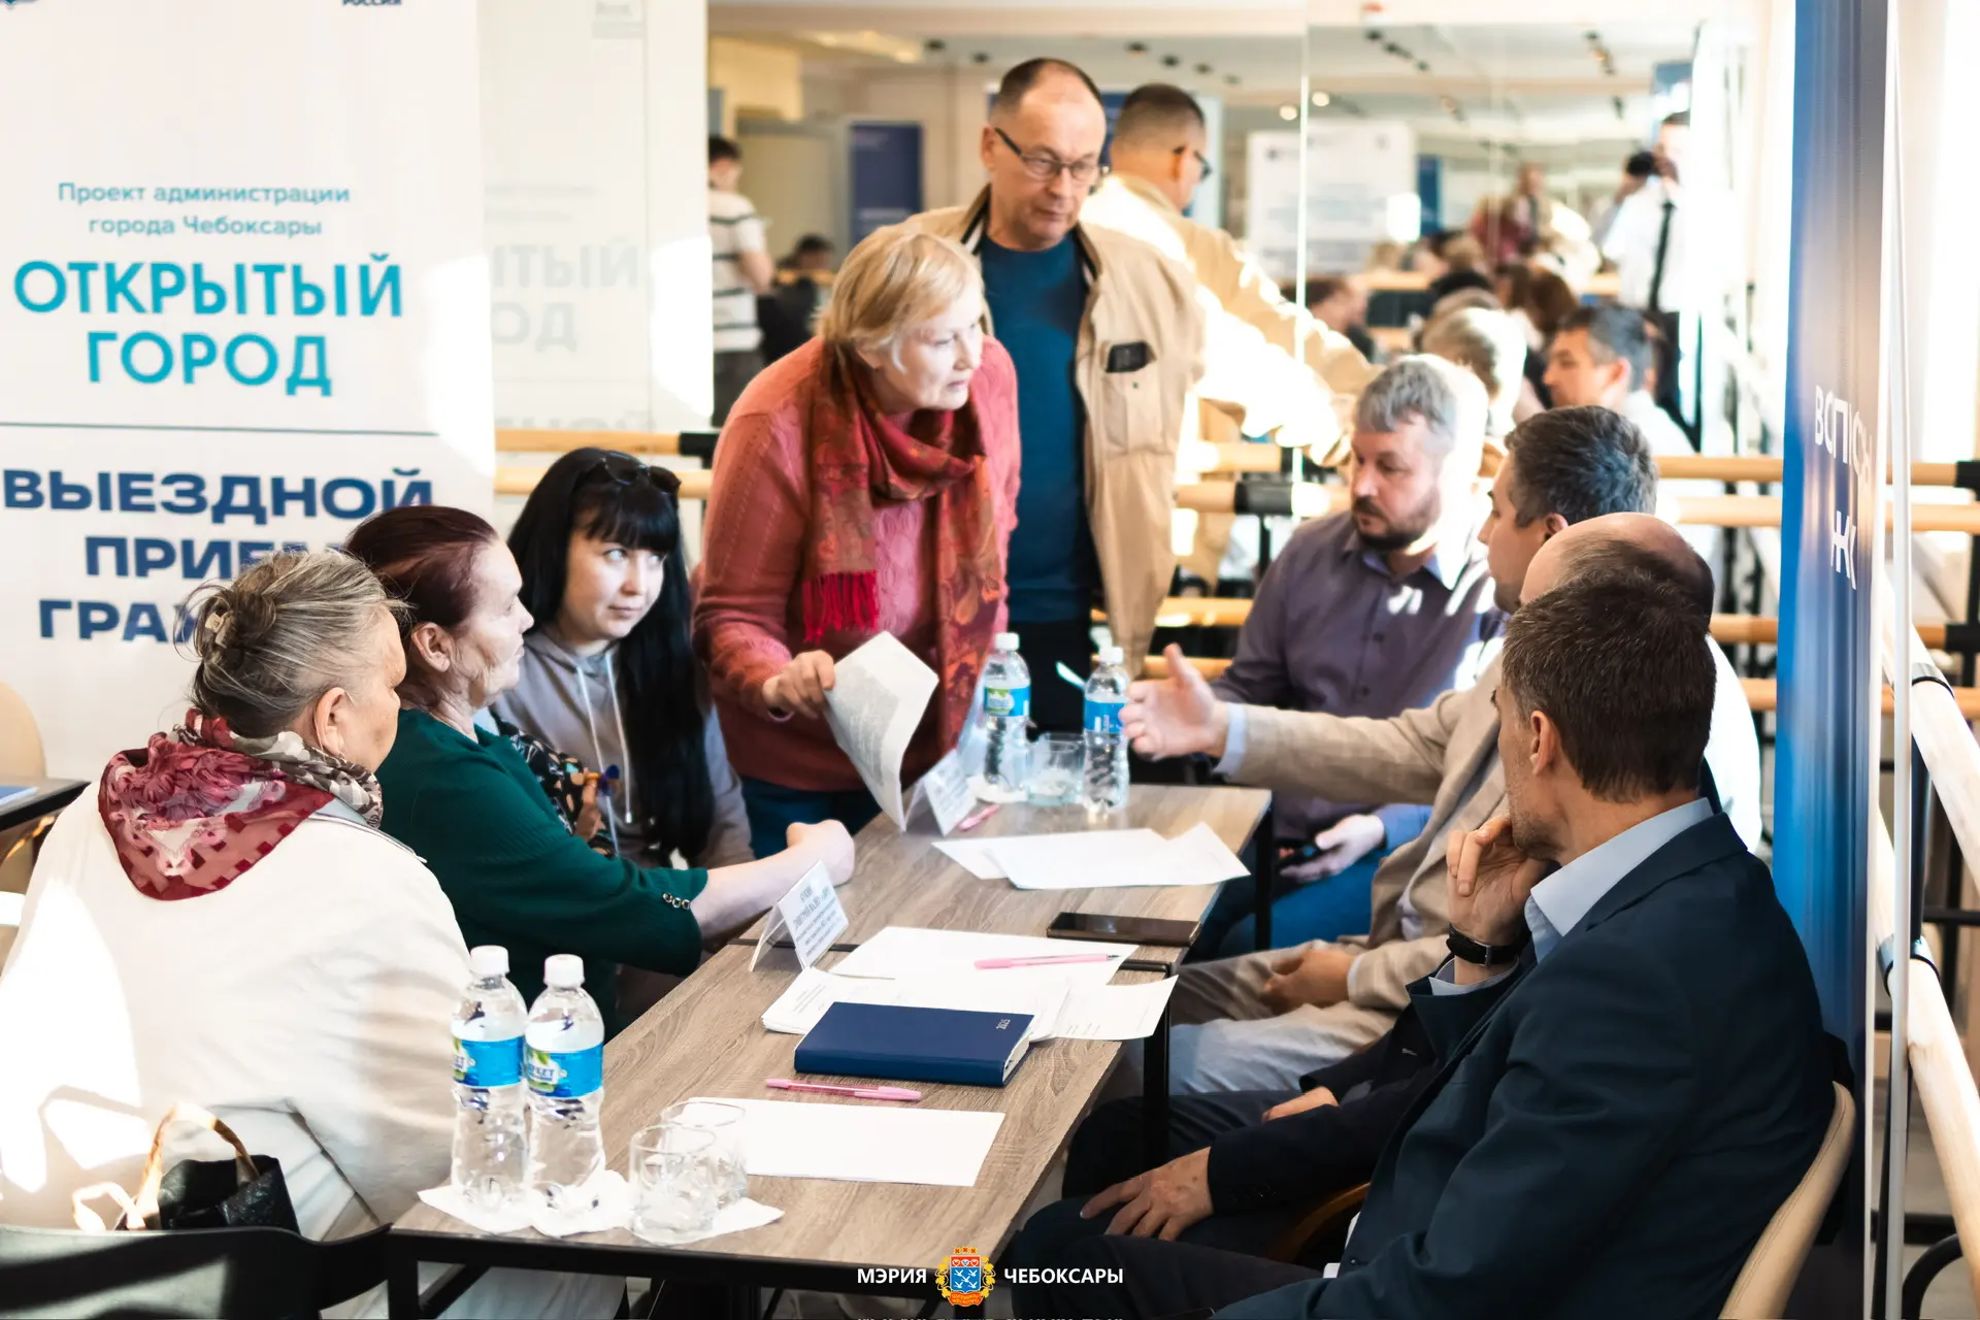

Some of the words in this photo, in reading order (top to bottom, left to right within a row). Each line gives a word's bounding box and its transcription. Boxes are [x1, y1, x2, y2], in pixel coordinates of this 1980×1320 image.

[58, 182, 146, 204] Проект
[153, 185, 350, 205] администрации
[89, 216, 175, 235] города
[183, 216, 322, 237] Чебоксары
[14, 254, 402, 316] ОТКРЫТЫЙ
[88, 331, 332, 397] ГОРОД
[3, 468, 433, 524] ВЫЕЗДНОЙ
